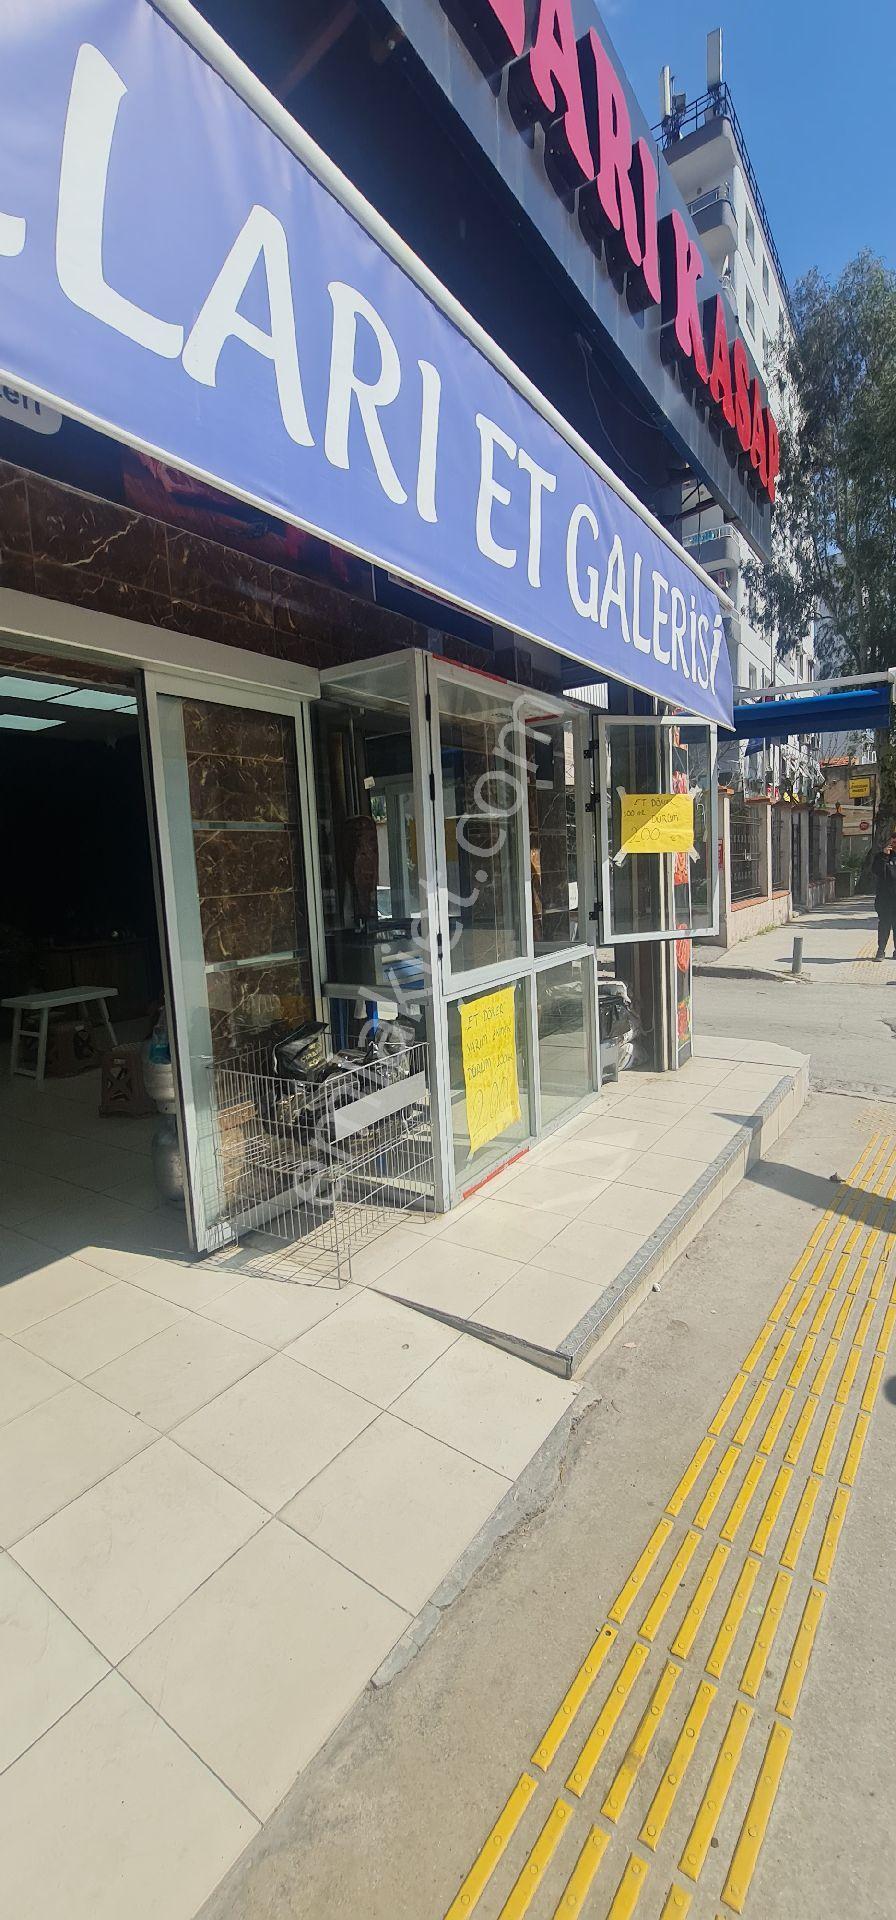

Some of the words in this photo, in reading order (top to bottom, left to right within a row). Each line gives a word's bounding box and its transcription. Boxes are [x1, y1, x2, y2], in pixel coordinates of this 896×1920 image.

[0, 42, 441, 524] LARI
[475, 412, 557, 588] ET
[566, 503, 722, 696] GALERİSİ
[487, 0, 661, 304] ARI
[672, 208, 781, 505] KASAP
